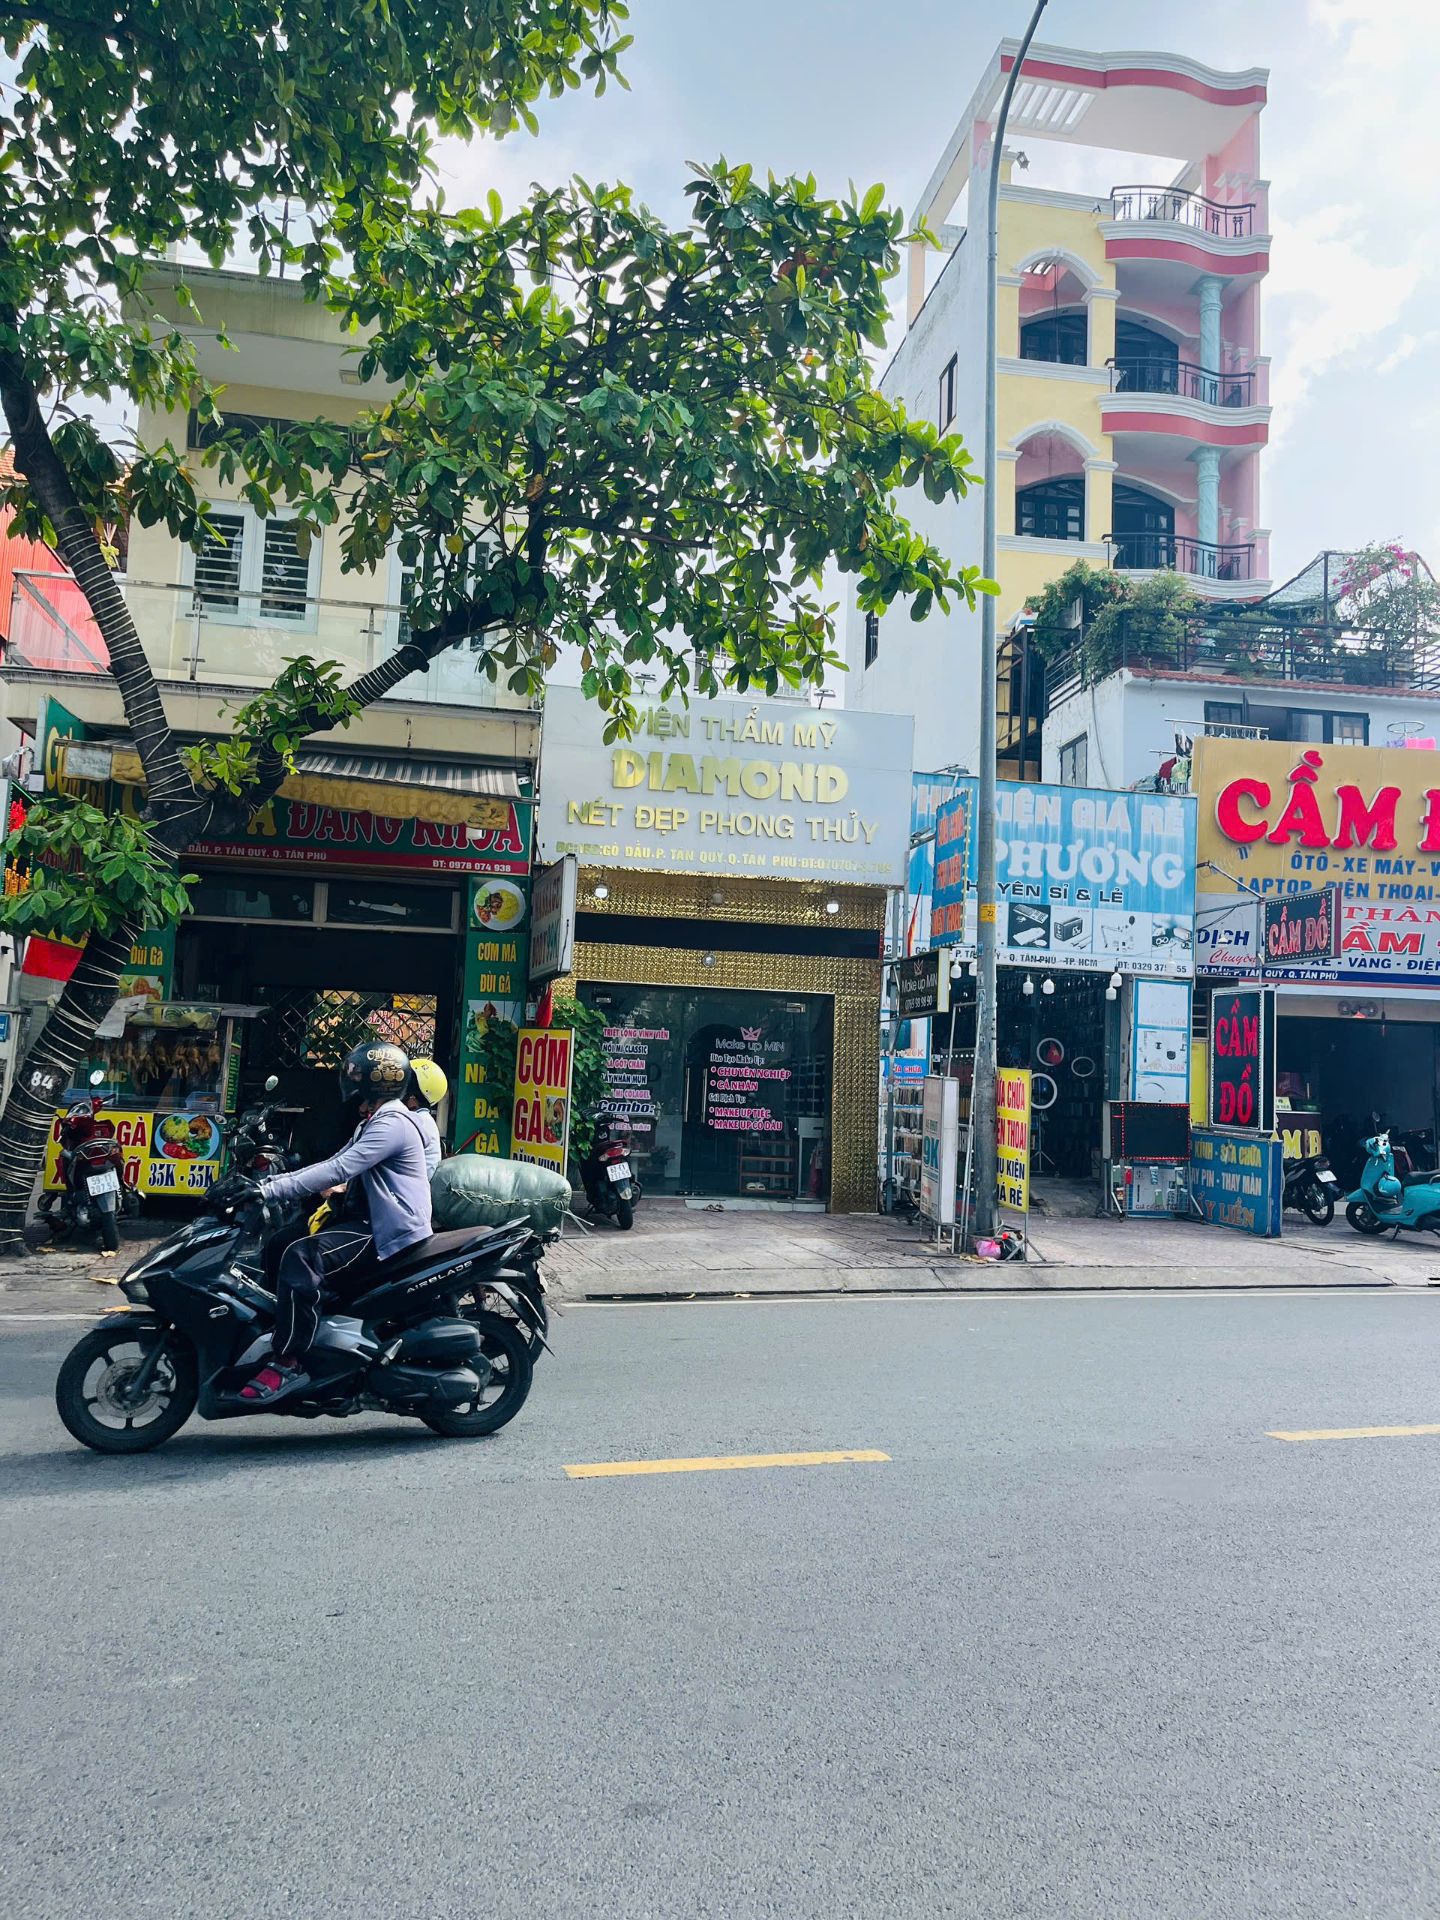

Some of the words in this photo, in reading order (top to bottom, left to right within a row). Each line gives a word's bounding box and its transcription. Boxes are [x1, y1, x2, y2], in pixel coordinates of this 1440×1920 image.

[632, 706, 691, 741] VIỆN
[700, 706, 785, 747] THẨM
[793, 720, 838, 749] MỸ
[611, 748, 850, 804] DIAMOND
[1214, 750, 1402, 850] CẦM
[566, 796, 625, 828] NÉT
[634, 806, 690, 836] ĐẸP
[699, 810, 796, 839] PHONG
[805, 807, 880, 845] THỦY
[1072, 795, 1132, 833] GIÁ
[449, 860, 472, 871] 0978
[474, 861, 492, 872] 074
[494, 862, 512, 873] 938
[1290, 850, 1329, 872] ÔTÔ
[1343, 856, 1368, 873] XE
[1374, 855, 1416, 876] MÁY
[1076, 889, 1091, 901] &
[1099, 887, 1123, 904] LẺ
[1343, 921, 1425, 956] ẦM
[477, 942, 499, 962] CƠM
[1348, 953, 1392, 969] VÀNG
[1078, 958, 1098, 968] HCM
[1132, 961, 1150, 972] 0329
[480, 970, 496, 993] ĐÙI
[1299, 969, 1318, 980] TÂN
[1319, 970, 1339, 981] PHÚ
[624, 1044, 648, 1055] CLASSIC
[715, 1038, 745, 1050] Make
[747, 1042, 763, 1053] up
[764, 1041, 785, 1052] MIN
[517, 1031, 569, 1089] CƠM
[31, 1070, 54, 1090] 84
[717, 1065, 757, 1079] CHUYÊN
[756, 1067, 792, 1082] NGHIỆP
[731, 1079, 758, 1091] NHÂN
[599, 1100, 656, 1114] Combo:
[714, 1107, 739, 1118] MAKE
[740, 1108, 753, 1119] UP
[514, 1090, 544, 1145] GÀ
[714, 1119, 740, 1130] MAKE
[740, 1119, 753, 1130] UP
[763, 1118, 784, 1132] DÂU
[116, 1115, 147, 1147] GÀ
[148, 1162, 177, 1188] 35K
[187, 1164, 216, 1189] 55K
[1006, 1158, 1026, 1182] KIỆN
[1201, 1168, 1215, 1188] PIN
[1009, 1183, 1023, 1207] RẺ
[406, 1259, 474, 1295] AIRBLADE
